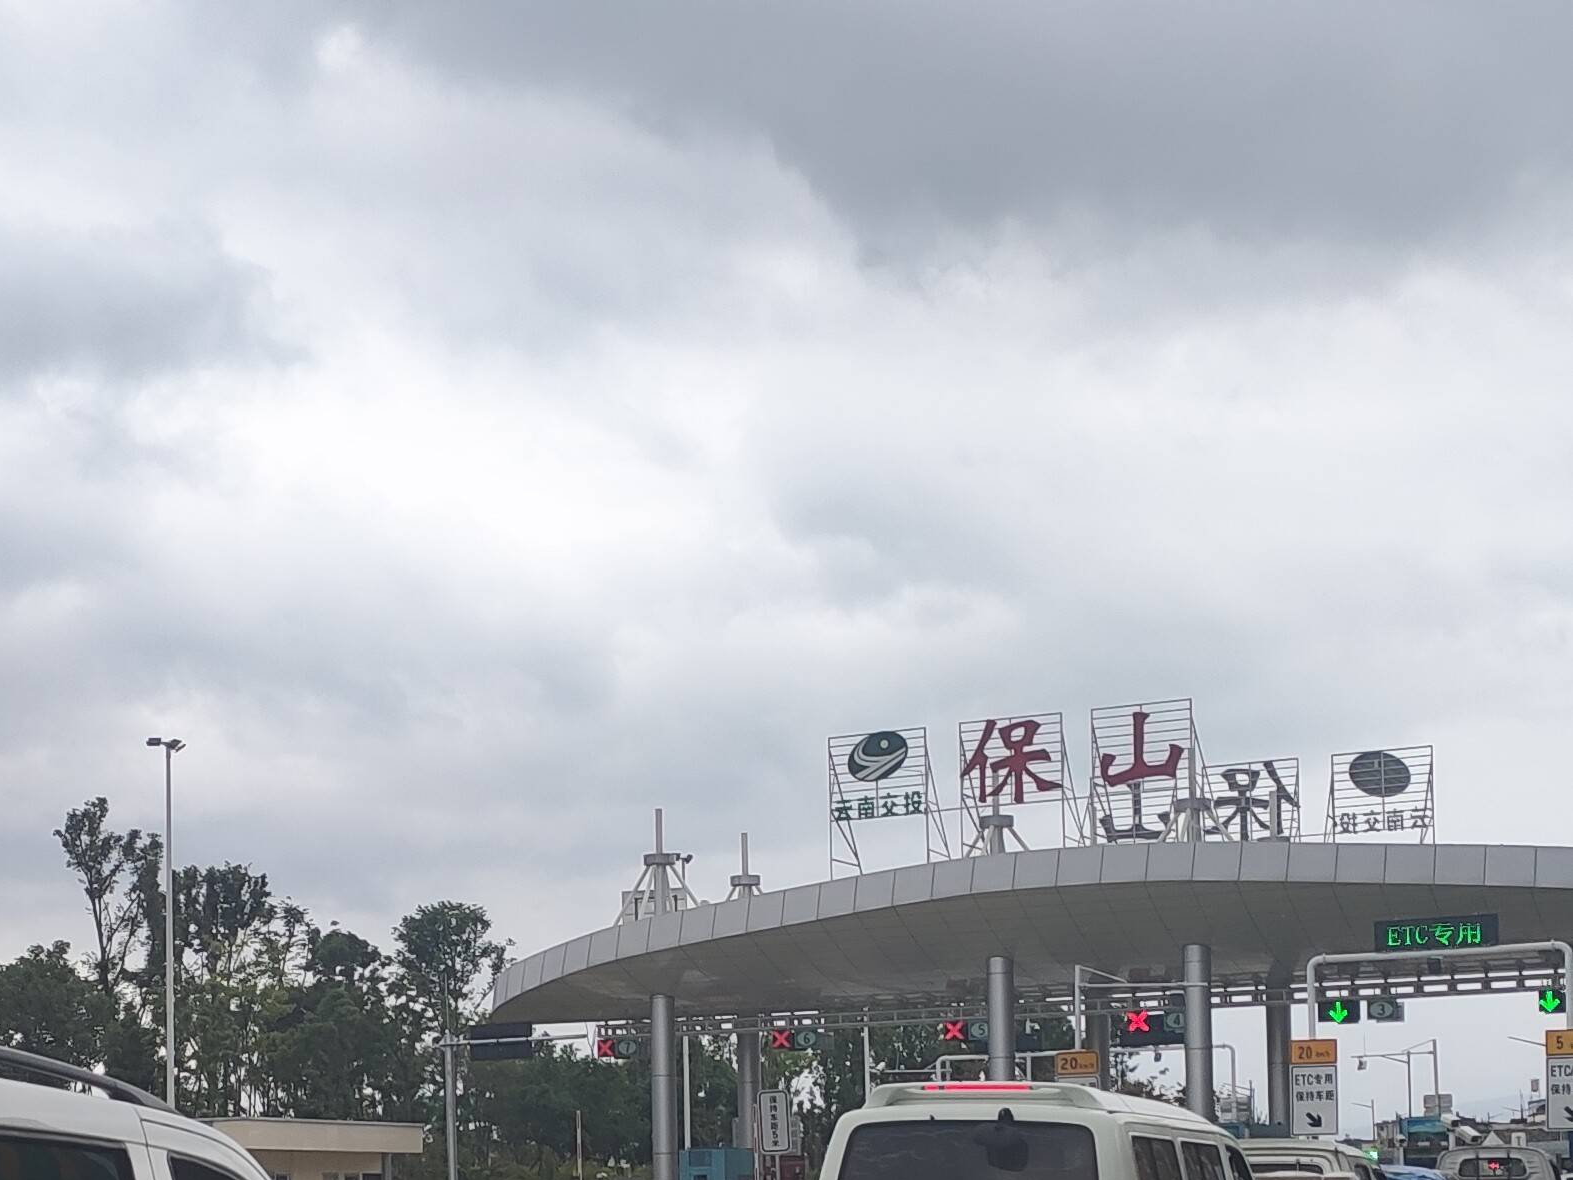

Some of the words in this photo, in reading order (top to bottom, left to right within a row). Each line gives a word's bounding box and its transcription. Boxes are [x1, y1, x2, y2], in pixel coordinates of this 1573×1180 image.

[961, 711, 1184, 803] 保山
[834, 791, 924, 820] 云南交投
[1386, 923, 1482, 947] ETC专用
[1377, 1003, 1386, 1016] 3
[978, 1023, 986, 1036] 5
[803, 1033, 811, 1045] 6
[1556, 1035, 1564, 1050] 5
[1298, 1046, 1313, 1060] 20
[1060, 1057, 1077, 1071] 20
[1295, 1073, 1333, 1086] ETC专用
[1296, 1089, 1335, 1102] 保持车距
